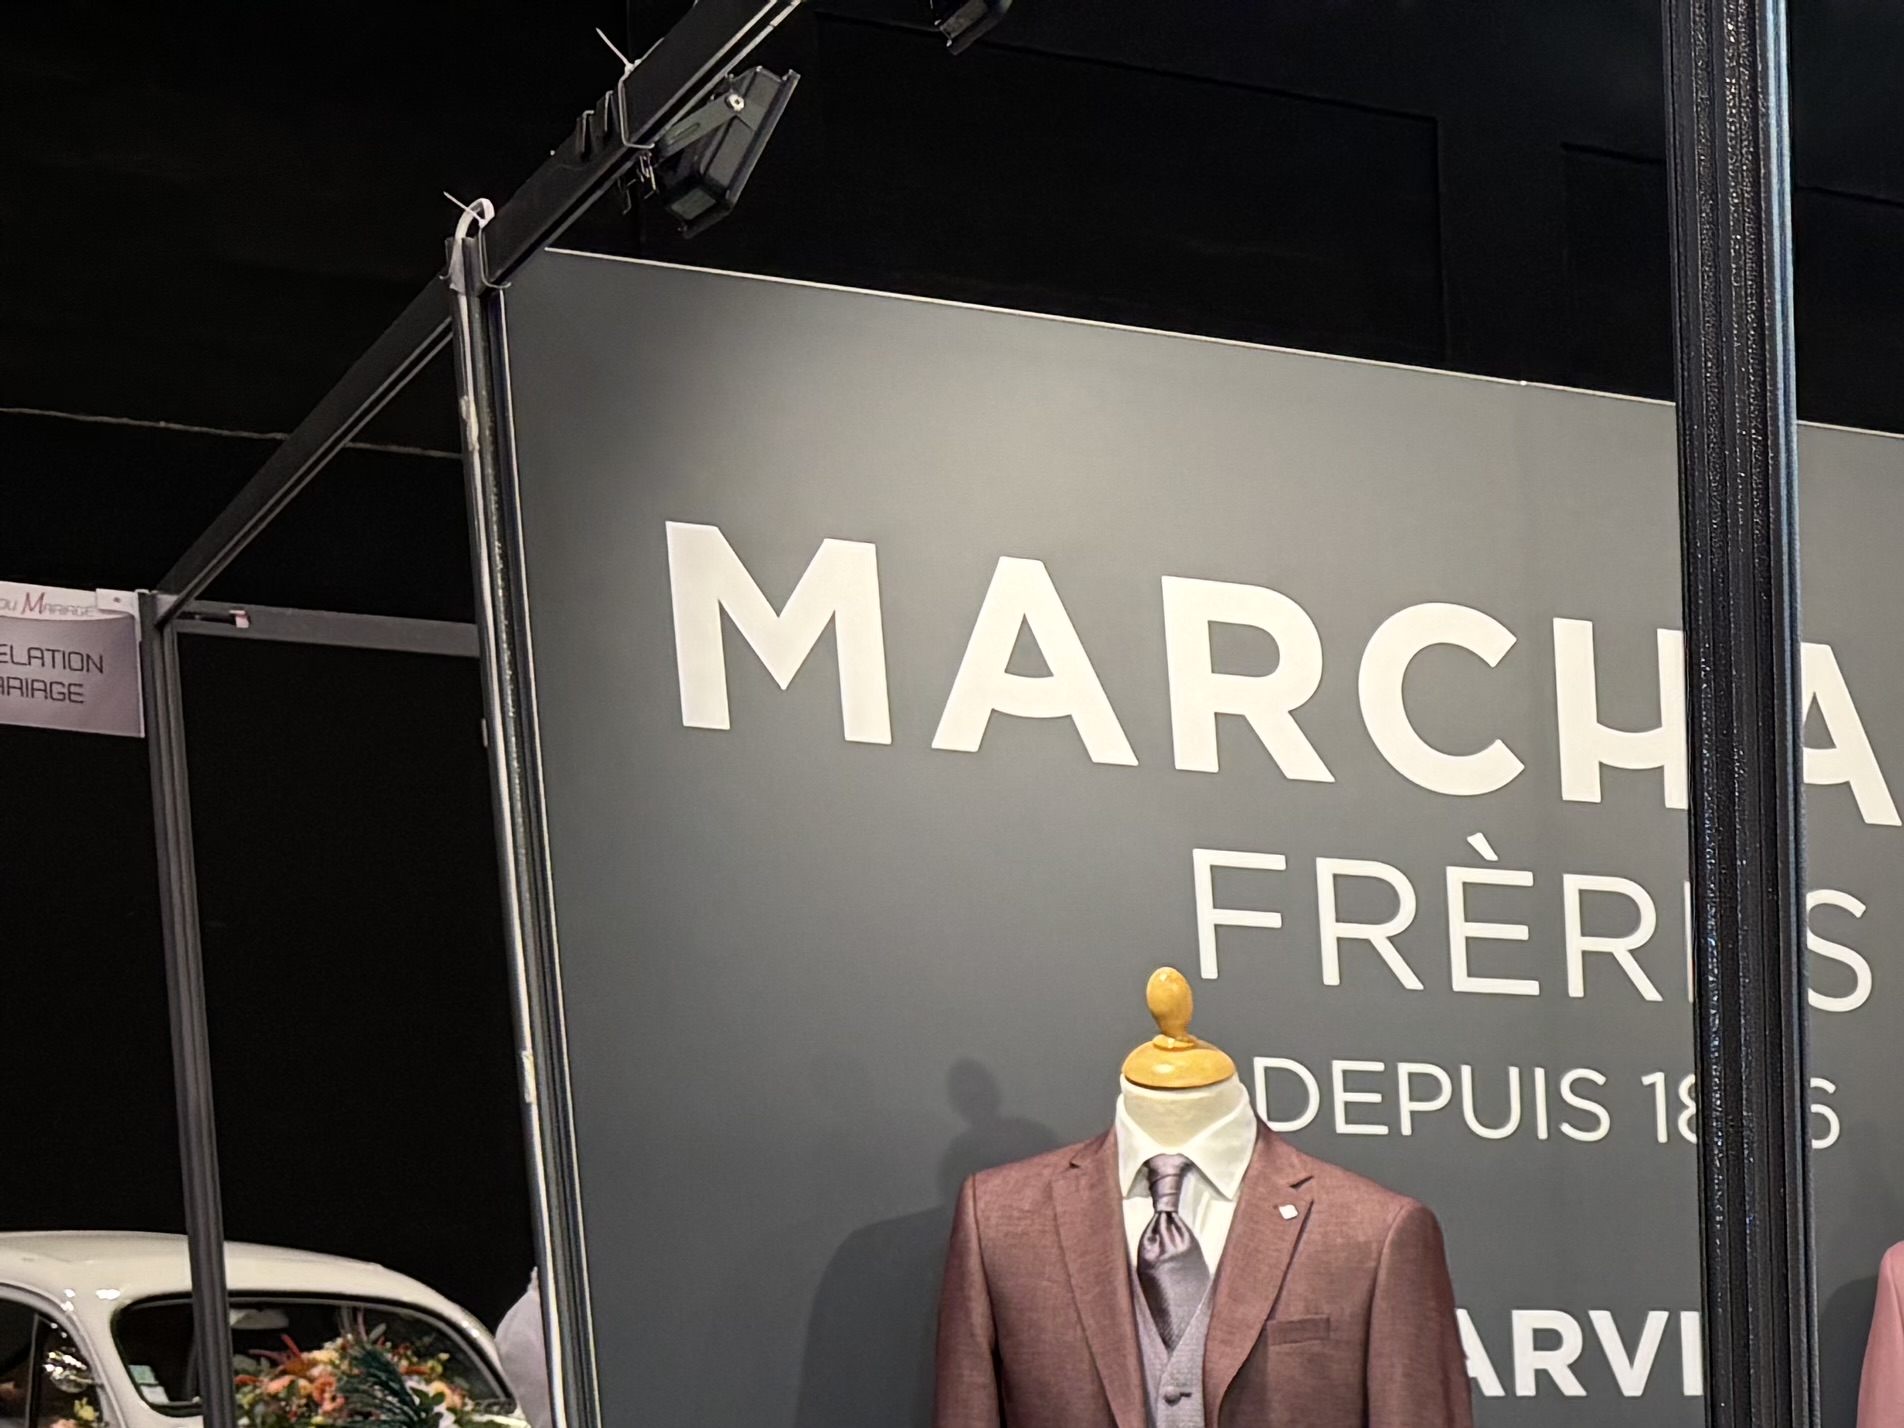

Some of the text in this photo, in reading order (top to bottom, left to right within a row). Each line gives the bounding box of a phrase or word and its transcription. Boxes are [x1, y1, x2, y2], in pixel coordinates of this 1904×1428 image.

[0, 675, 85, 704] RIAGE
[1192, 832, 1873, 1013] FRÈRS
[1253, 1056, 1611, 1144] DEPUIS
